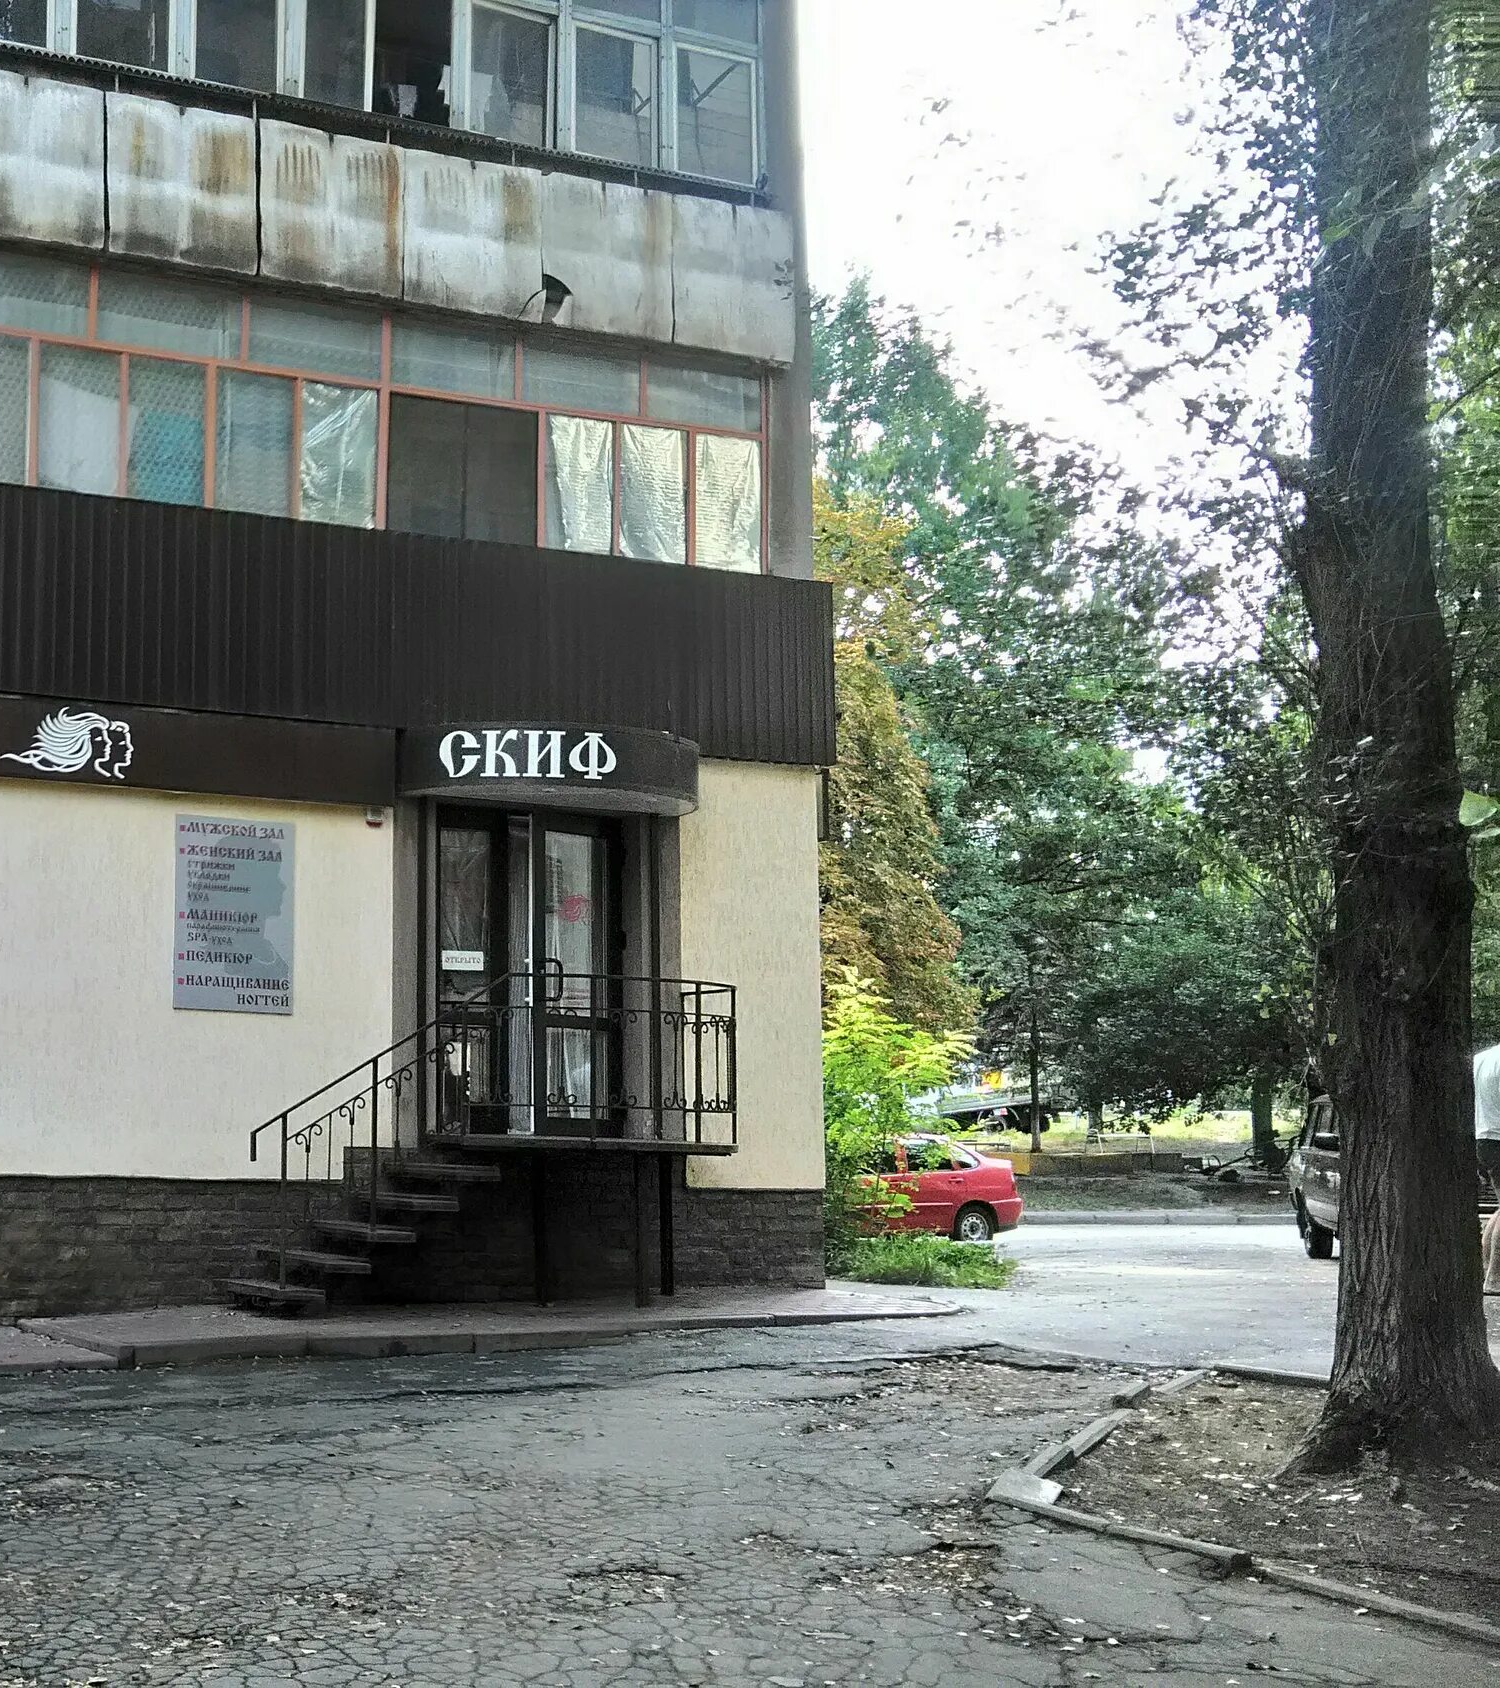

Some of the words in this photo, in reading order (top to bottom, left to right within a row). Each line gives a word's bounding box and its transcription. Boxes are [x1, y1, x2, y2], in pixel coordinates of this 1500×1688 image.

[439, 728, 617, 780] СКИФ
[187, 821, 257, 838] МУЖСКОЙ
[259, 826, 285, 840] ЗАЛ
[186, 844, 255, 861] ЖЕНСКИЙ
[258, 850, 282, 863] ЗАЛ
[186, 908, 258, 924] МАНИКЮР
[186, 950, 253, 965] ПЕДИКЮР
[186, 974, 290, 990] НАРАЩИВАНИЕ
[237, 993, 290, 1007] НОГТЕЙ
